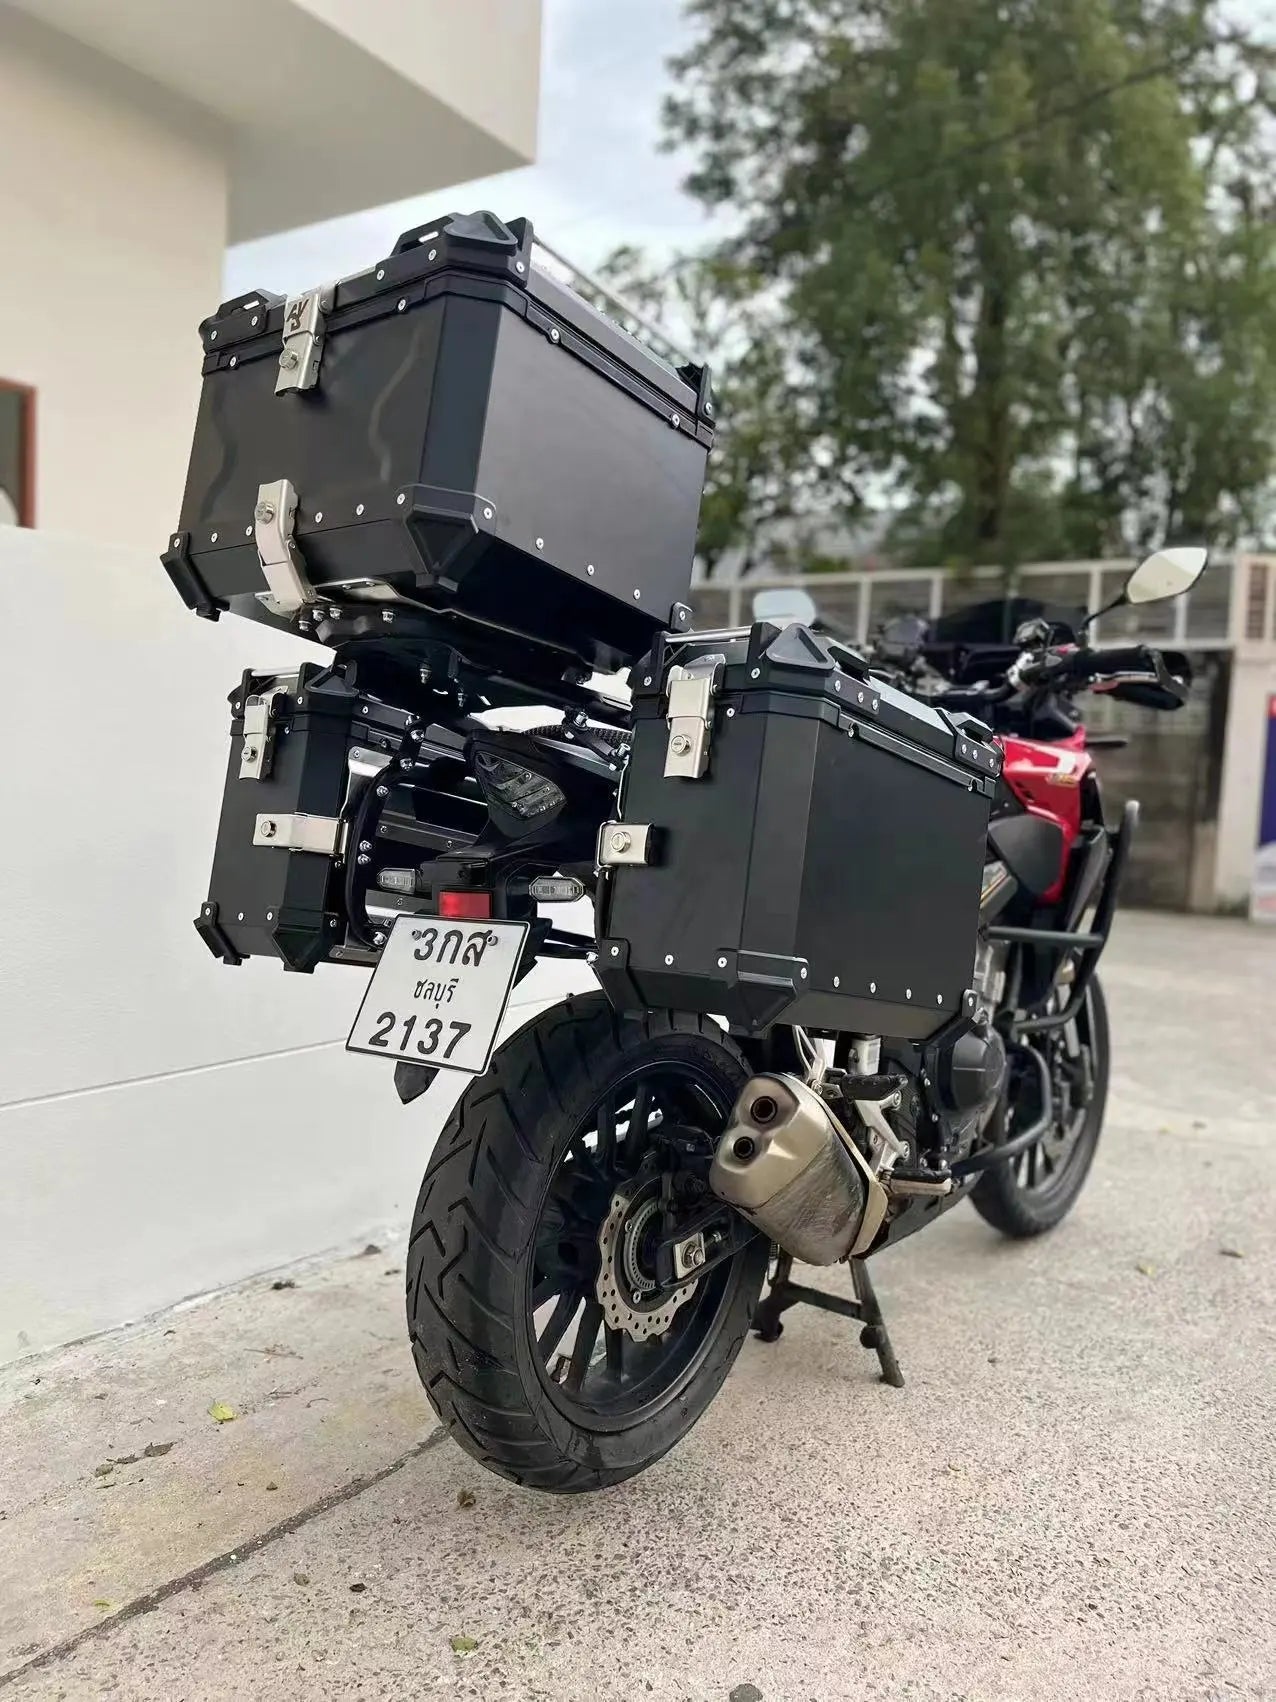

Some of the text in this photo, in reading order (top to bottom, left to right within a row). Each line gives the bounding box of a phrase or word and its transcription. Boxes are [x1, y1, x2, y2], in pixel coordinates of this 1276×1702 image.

[414, 928, 493, 967] 3กส
[413, 978, 459, 1009] ชลบุรี
[368, 1011, 472, 1059] 2137
